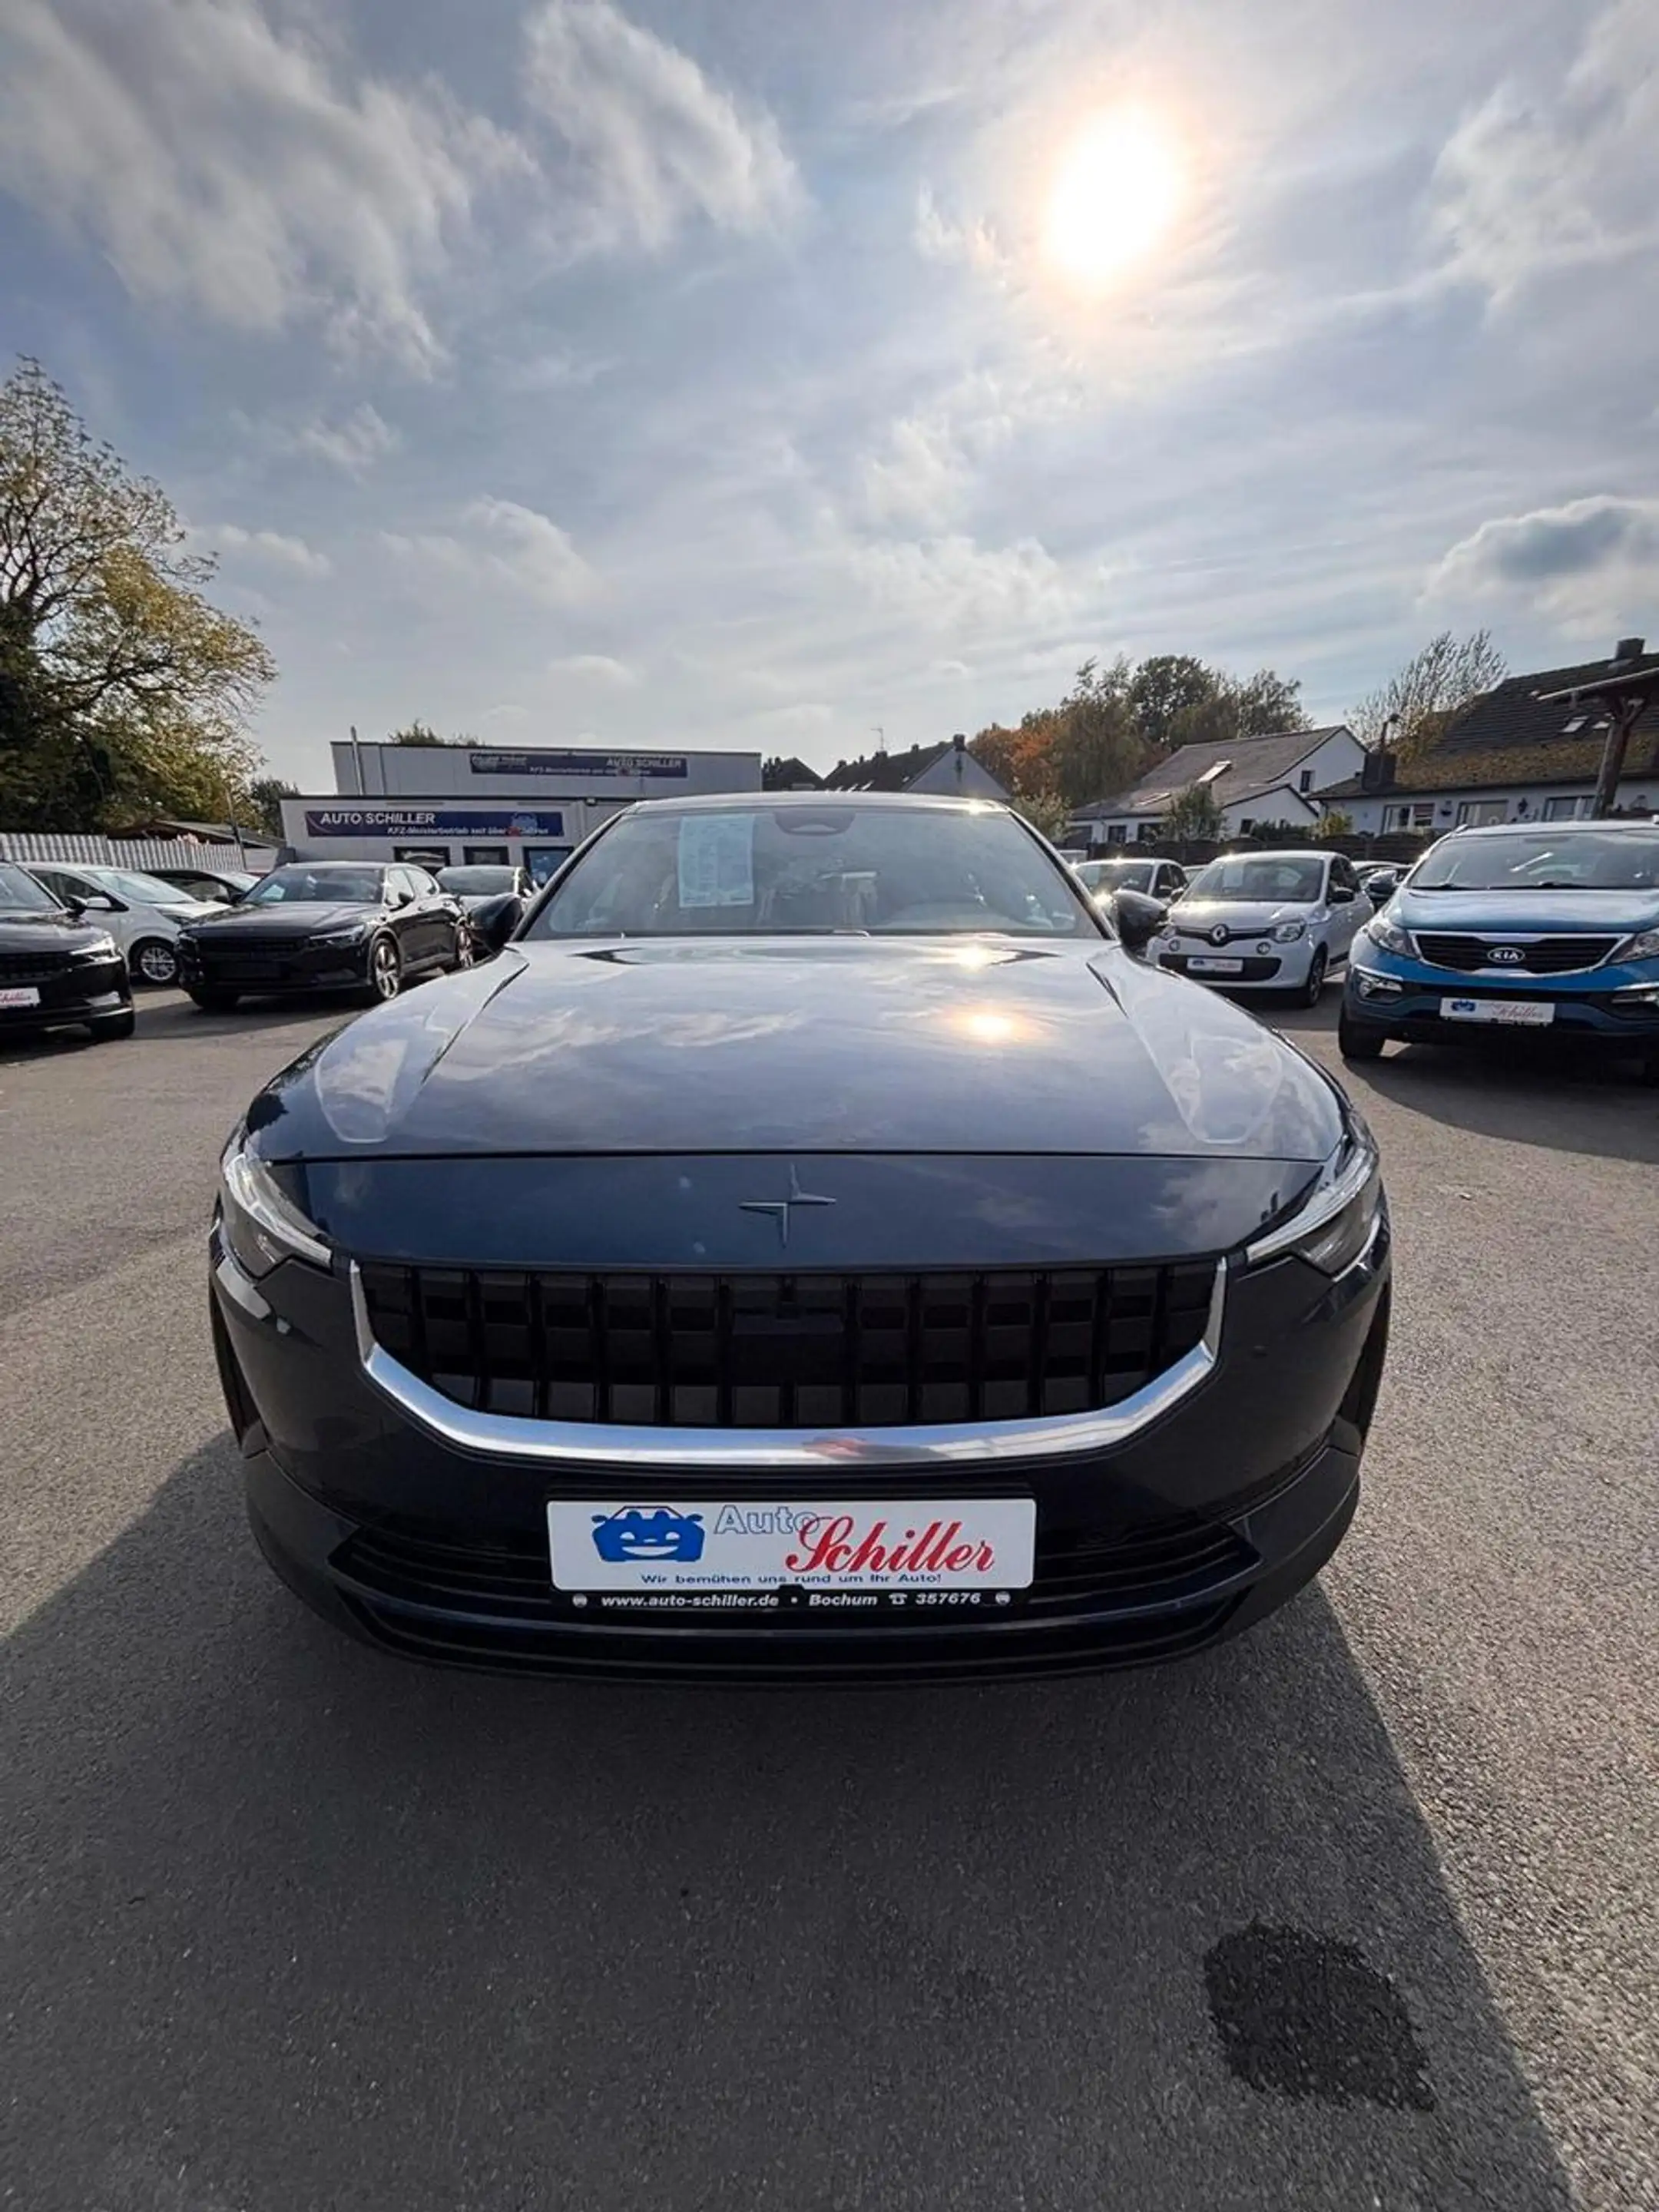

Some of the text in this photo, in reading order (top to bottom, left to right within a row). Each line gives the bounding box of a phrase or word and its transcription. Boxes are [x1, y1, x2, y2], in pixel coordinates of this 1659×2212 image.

[320, 812, 435, 825] AUTO SCHILLER
[1492, 951, 1519, 960] KIA
[713, 1505, 995, 1573] Auto Schiller
[641, 1575, 667, 1584] Wir
[675, 1575, 751, 1584] bemühen
[758, 1575, 786, 1584] uns
[794, 1575, 831, 1584] rund
[870, 1574, 889, 1583] Ihr
[897, 1574, 942, 1583] Auto!
[601, 1591, 982, 1608] www.auto-schiller.de Bochum 357676
